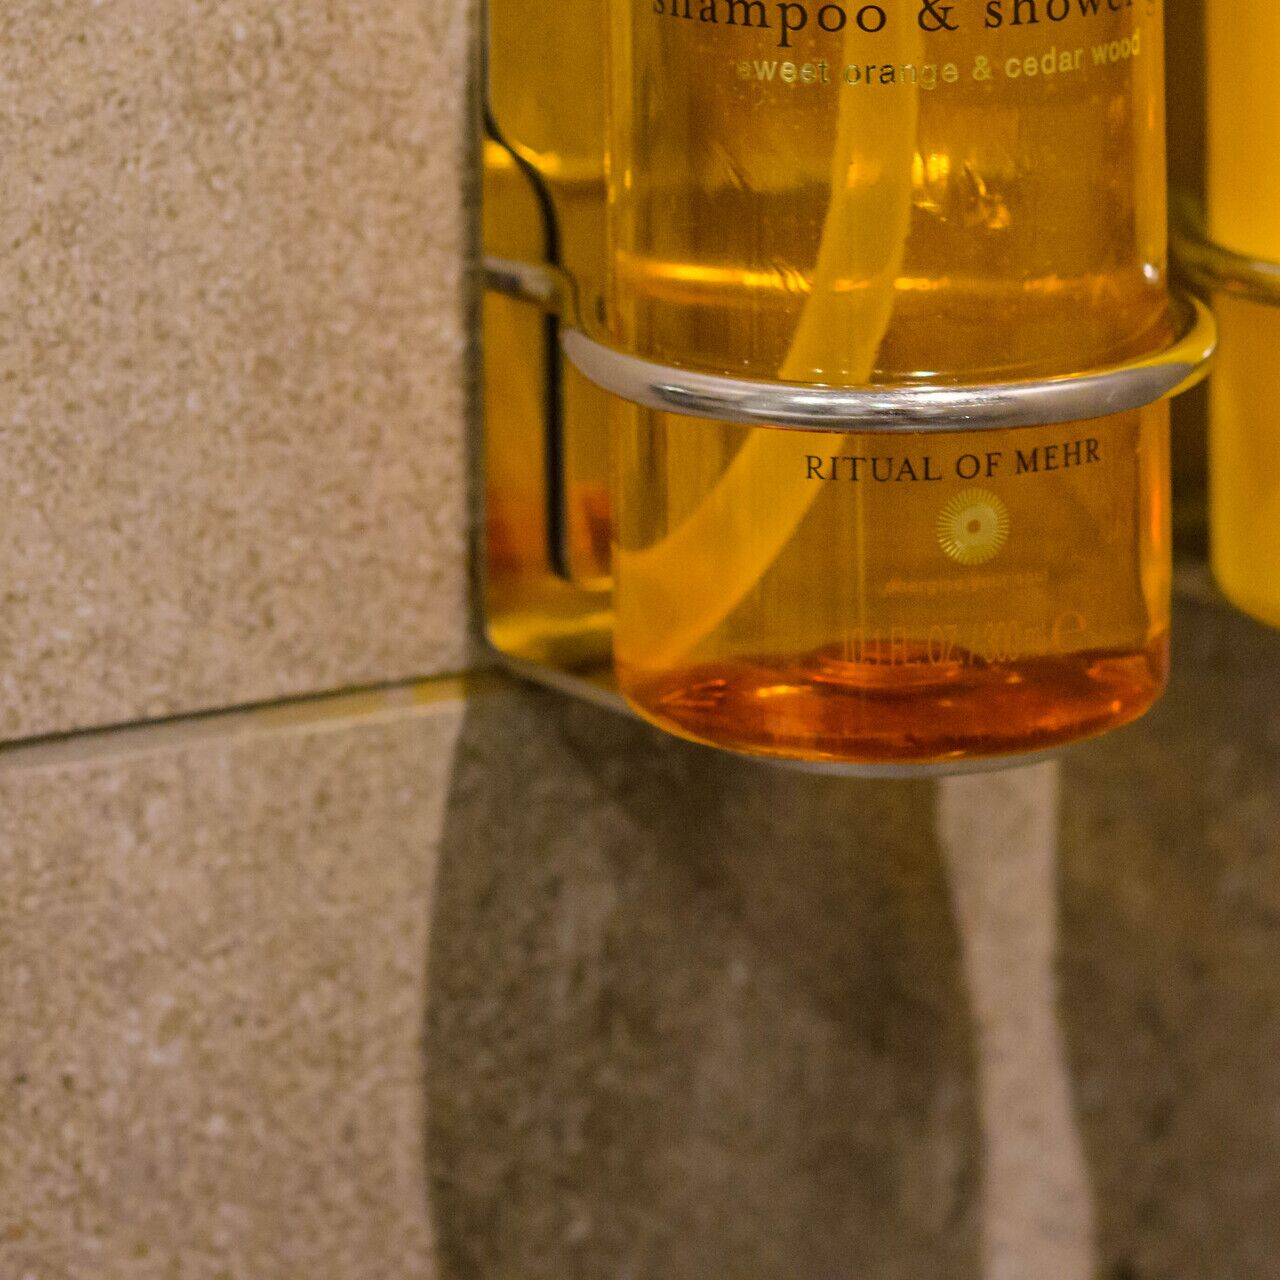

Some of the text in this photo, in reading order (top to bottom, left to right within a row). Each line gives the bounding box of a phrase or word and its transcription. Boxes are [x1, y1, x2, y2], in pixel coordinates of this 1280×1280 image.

[736, 27, 1142, 90] sweet orange & cedar wood
[805, 437, 1102, 483] RITUAL OF MEHR
